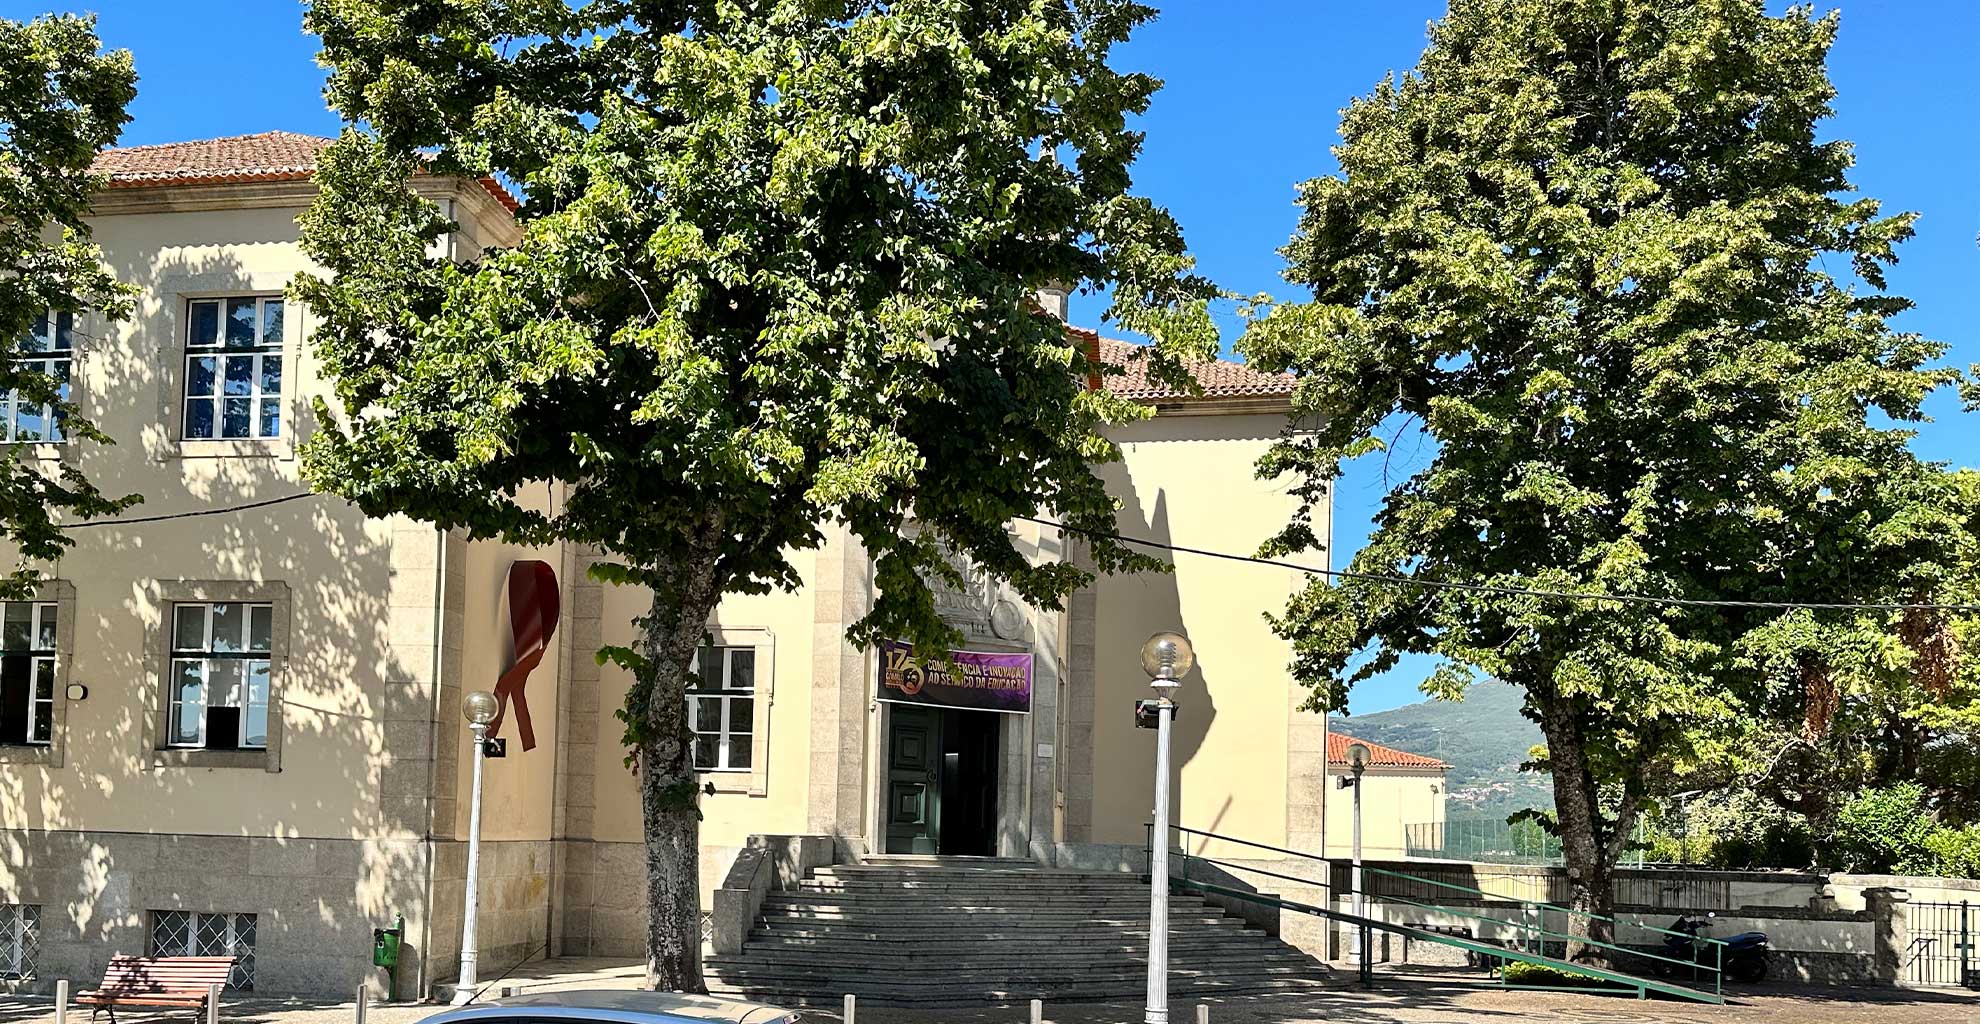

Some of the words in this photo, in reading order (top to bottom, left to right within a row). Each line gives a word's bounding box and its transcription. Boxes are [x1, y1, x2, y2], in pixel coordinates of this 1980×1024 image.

[927, 659, 982, 676] COMPTÊNCIA
[982, 664, 989, 677] E
[989, 665, 1026, 679] INOVAÇÃO
[927, 671, 940, 685] AO
[975, 676, 986, 689] DA
[987, 677, 1026, 691] EDUCAÇÃO
